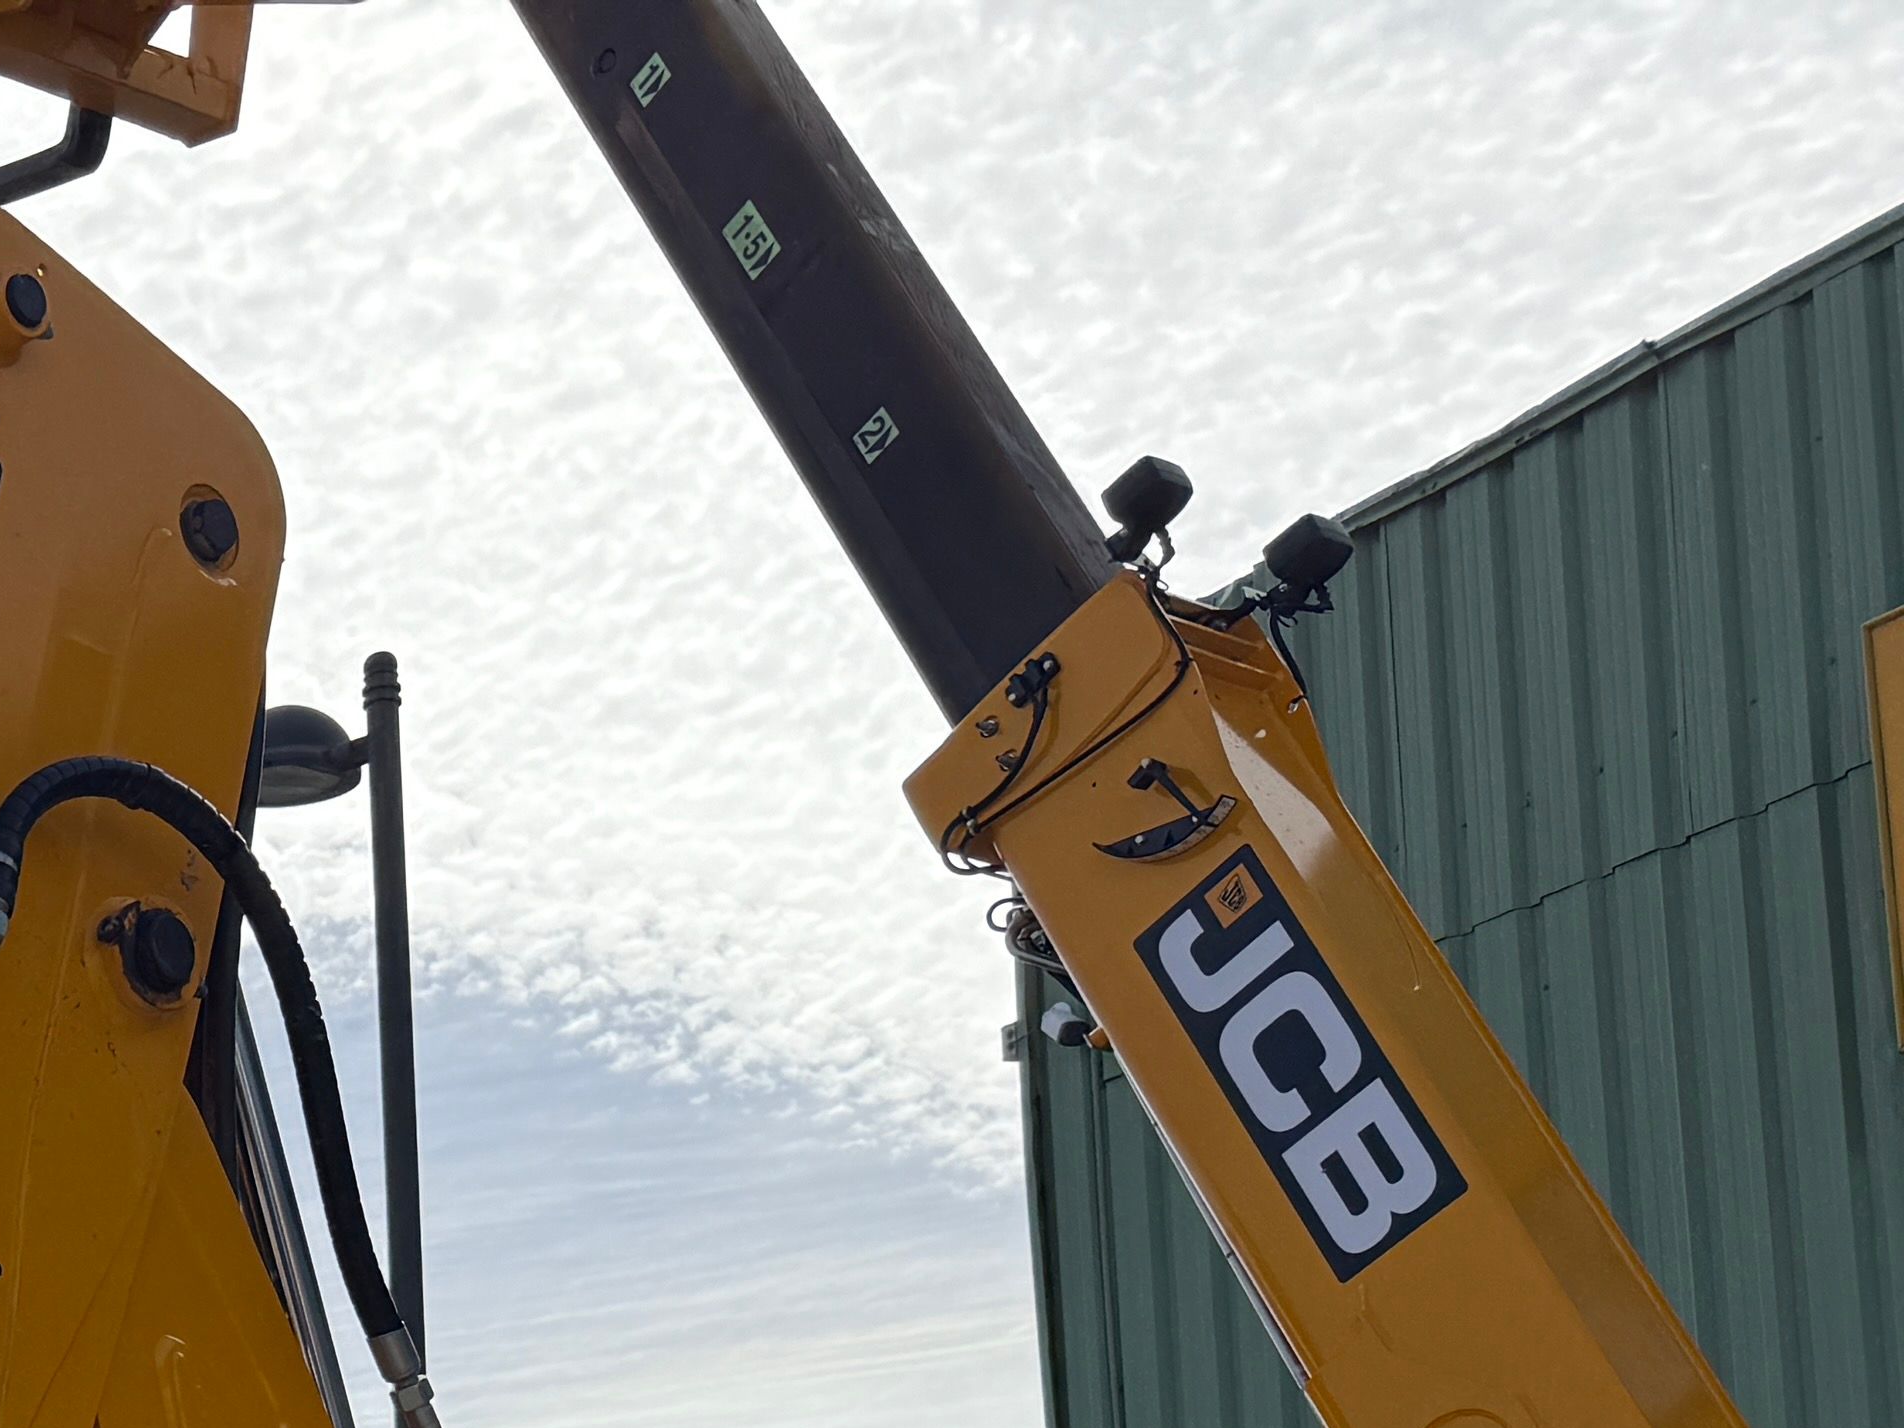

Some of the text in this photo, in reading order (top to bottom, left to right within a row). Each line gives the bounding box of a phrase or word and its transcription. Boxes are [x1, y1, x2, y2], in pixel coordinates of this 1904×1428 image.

[638, 63, 660, 90] 1
[858, 416, 886, 448] 2
[1158, 908, 1438, 1254] JCB
